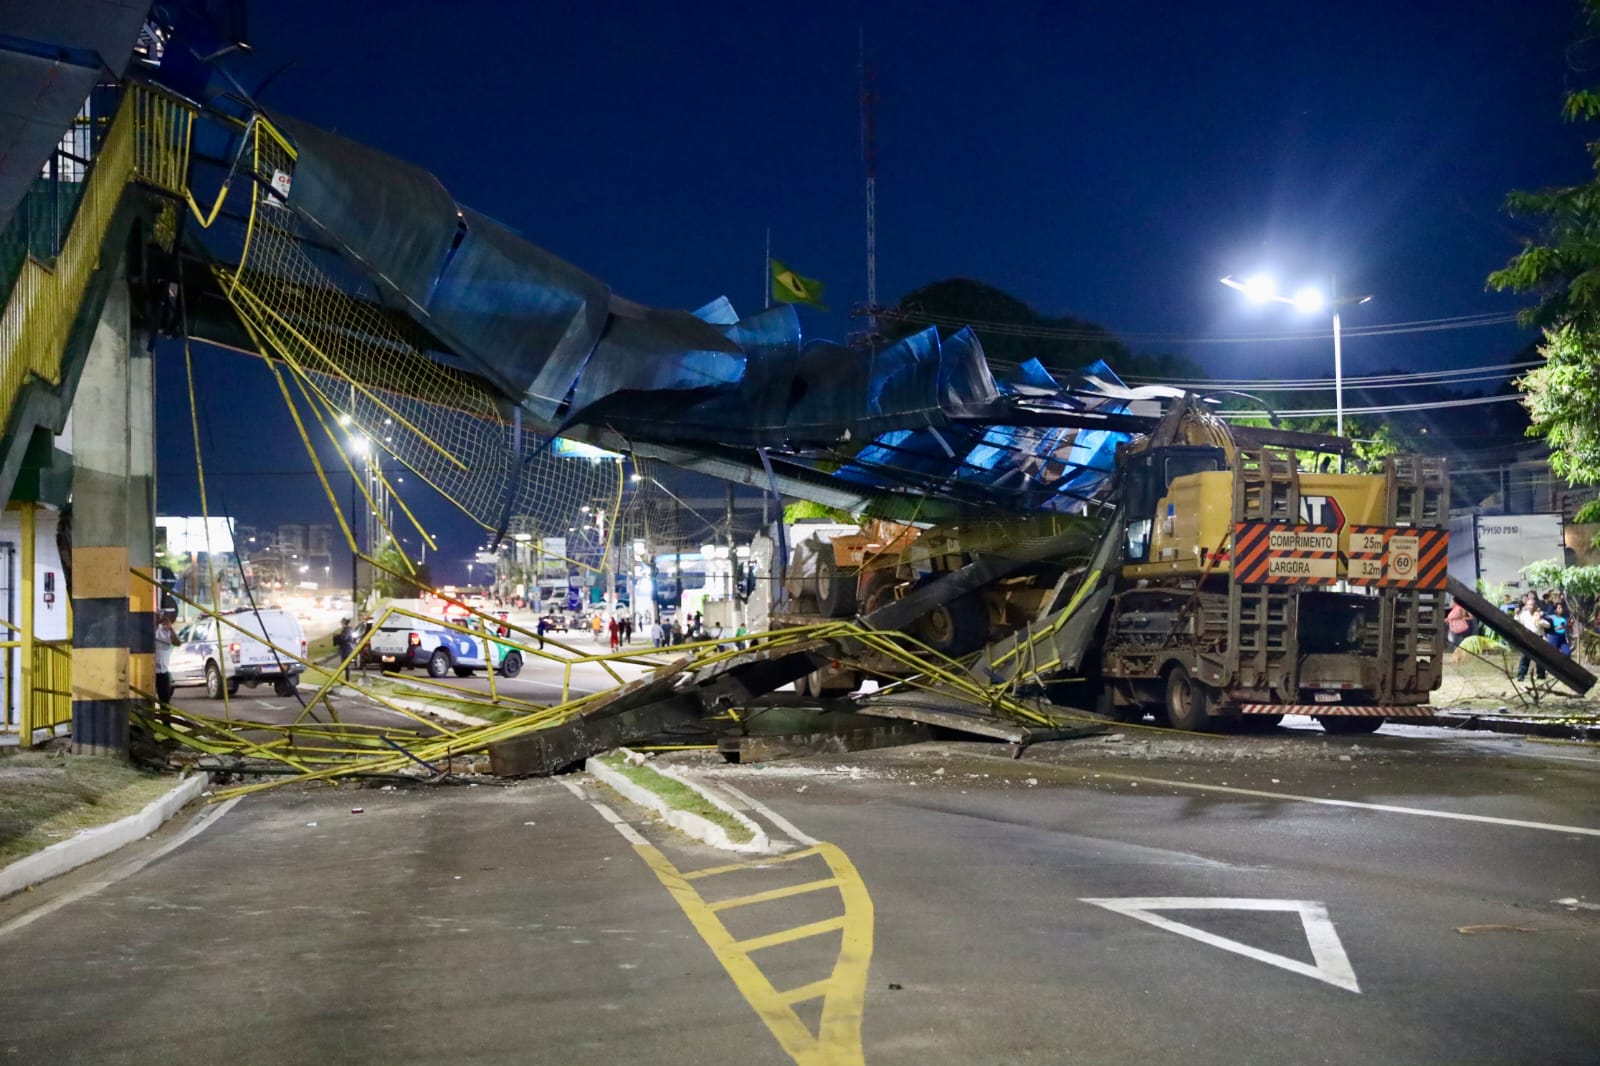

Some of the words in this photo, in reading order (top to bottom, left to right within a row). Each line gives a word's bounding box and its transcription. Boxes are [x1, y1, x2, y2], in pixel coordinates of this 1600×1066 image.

[1270, 535, 1333, 549] COMPRIMENTO
[1363, 536, 1382, 550] 25m
[1396, 557, 1409, 568] 60
